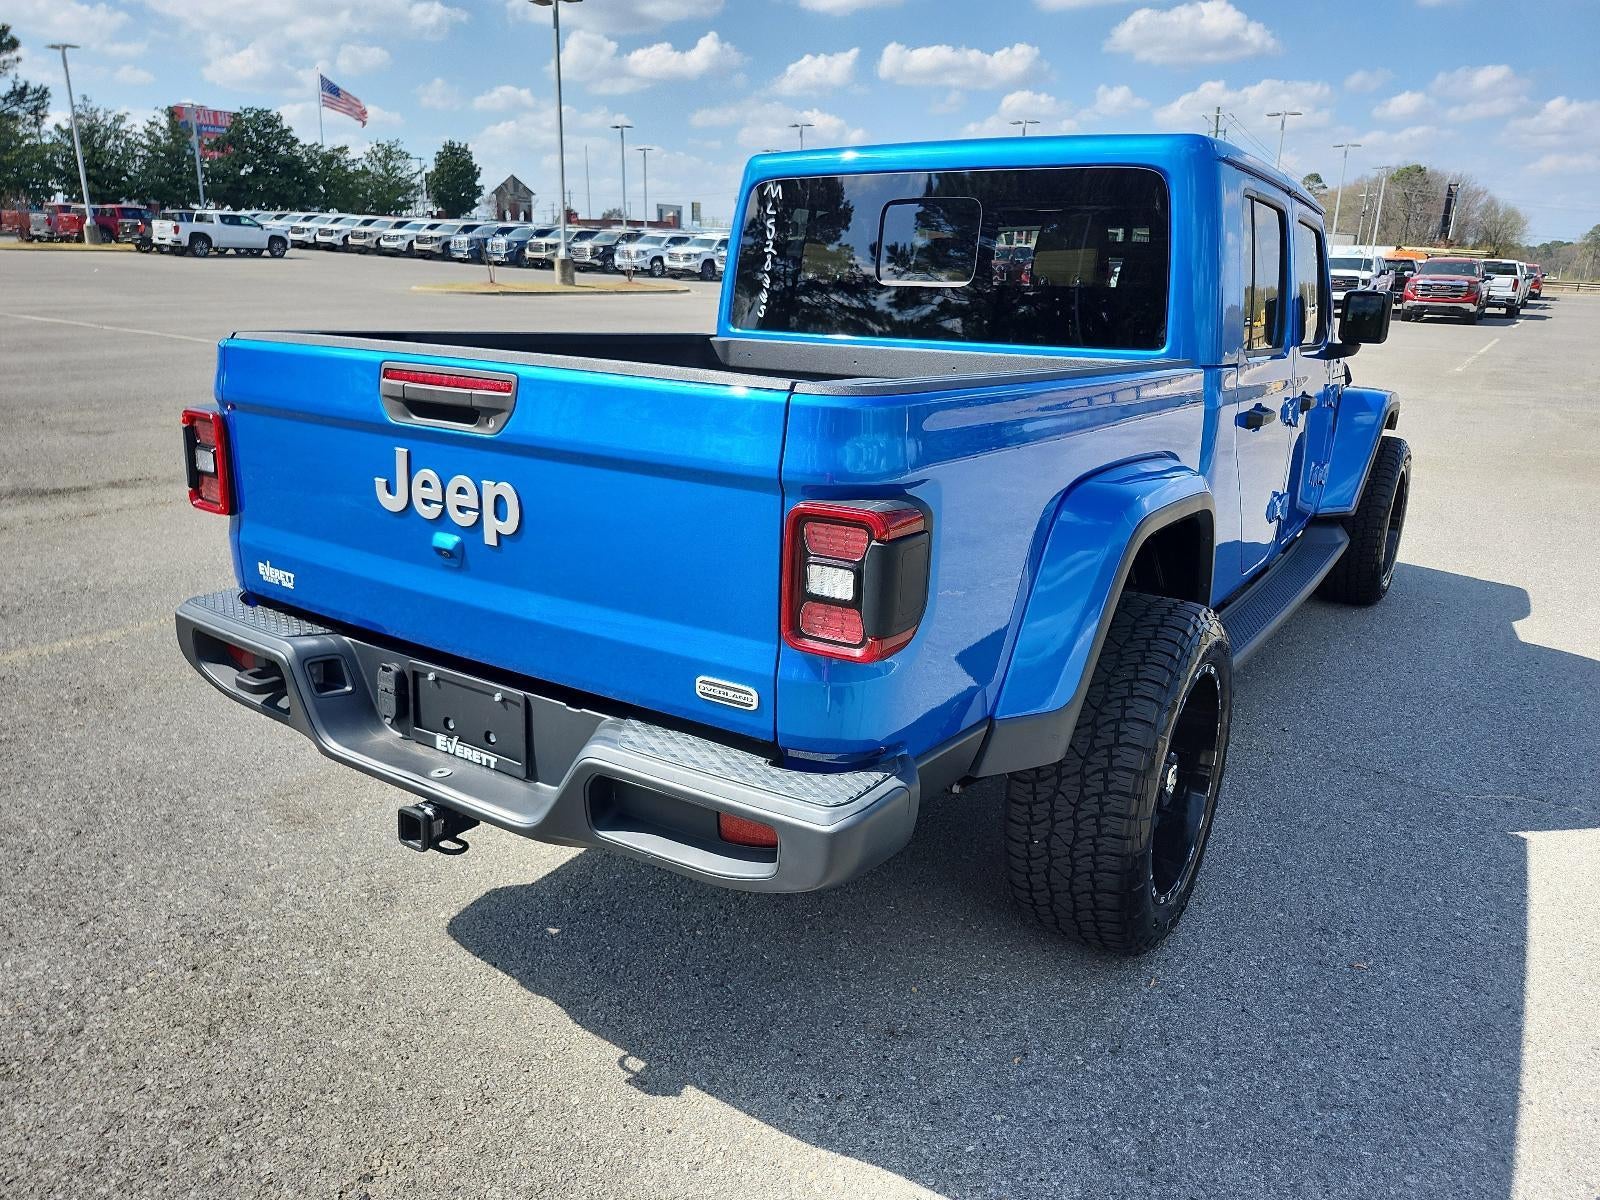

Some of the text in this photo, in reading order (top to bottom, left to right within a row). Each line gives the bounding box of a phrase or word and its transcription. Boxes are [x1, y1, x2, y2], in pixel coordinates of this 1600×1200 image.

[374, 447, 520, 547] Jeep
[258, 560, 295, 584] EVERETT
[698, 684, 755, 703] OVERLAND
[435, 732, 498, 769] EVERETT
